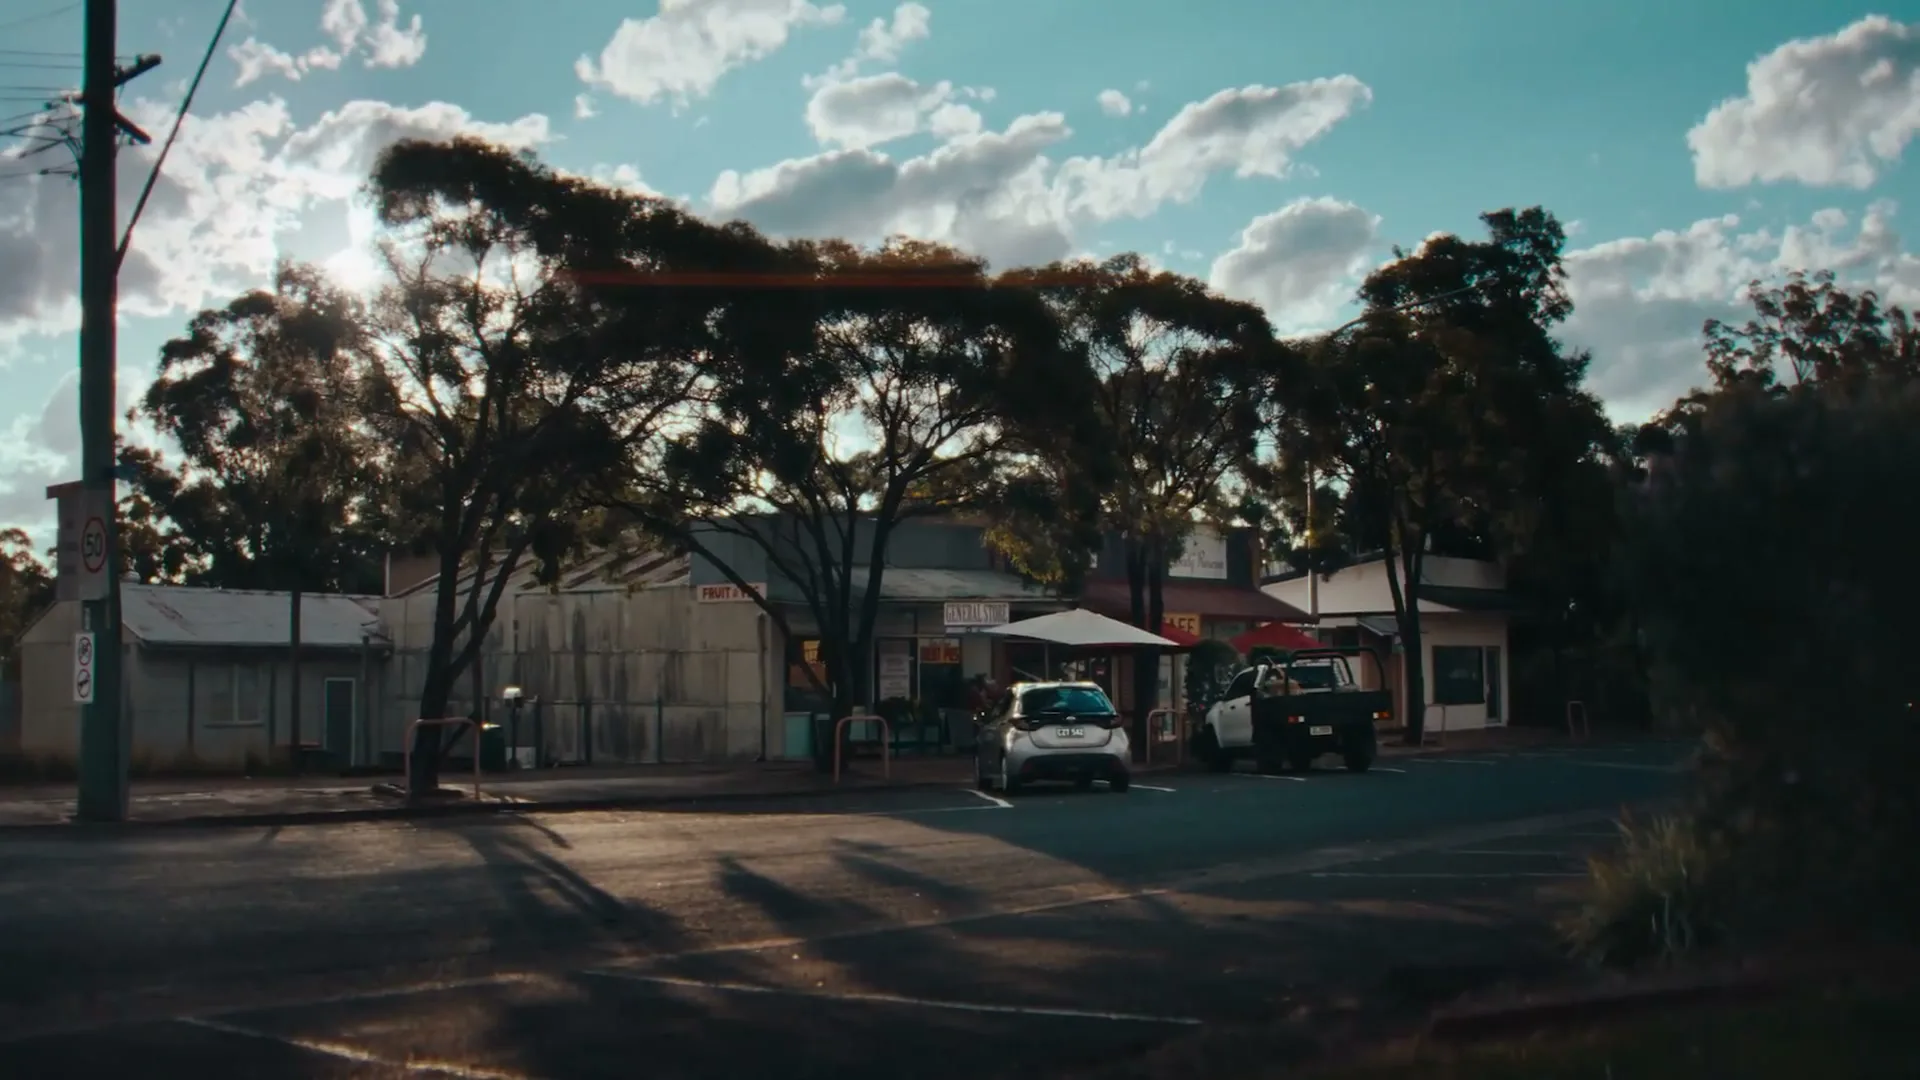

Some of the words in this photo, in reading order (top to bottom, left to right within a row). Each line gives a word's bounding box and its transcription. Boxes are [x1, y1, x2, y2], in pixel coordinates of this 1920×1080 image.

[85, 533, 102, 557] 50
[702, 587, 730, 599] FRUIT
[946, 604, 982, 623] GENERAL
[983, 604, 1007, 624] STORE
